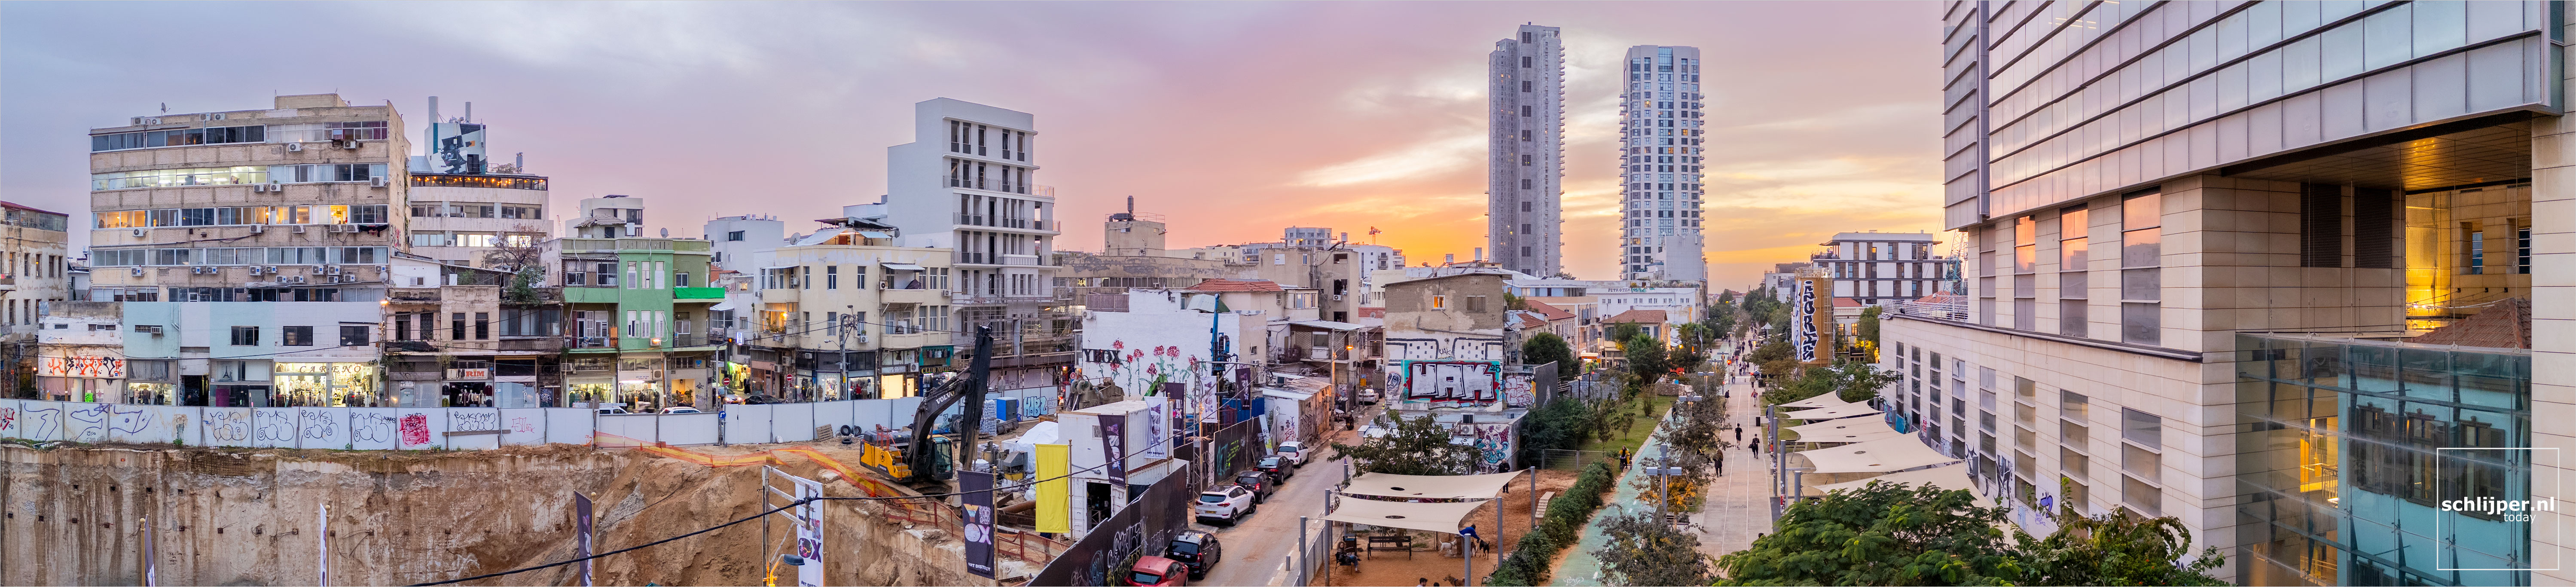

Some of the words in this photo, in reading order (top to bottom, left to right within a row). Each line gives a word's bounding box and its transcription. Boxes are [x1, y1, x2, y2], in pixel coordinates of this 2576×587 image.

[1082, 349, 1120, 365] YBOX
[299, 365, 361, 375] CARENO
[1490, 364, 1501, 373] 25
[936, 390, 955, 404] VOLVO
